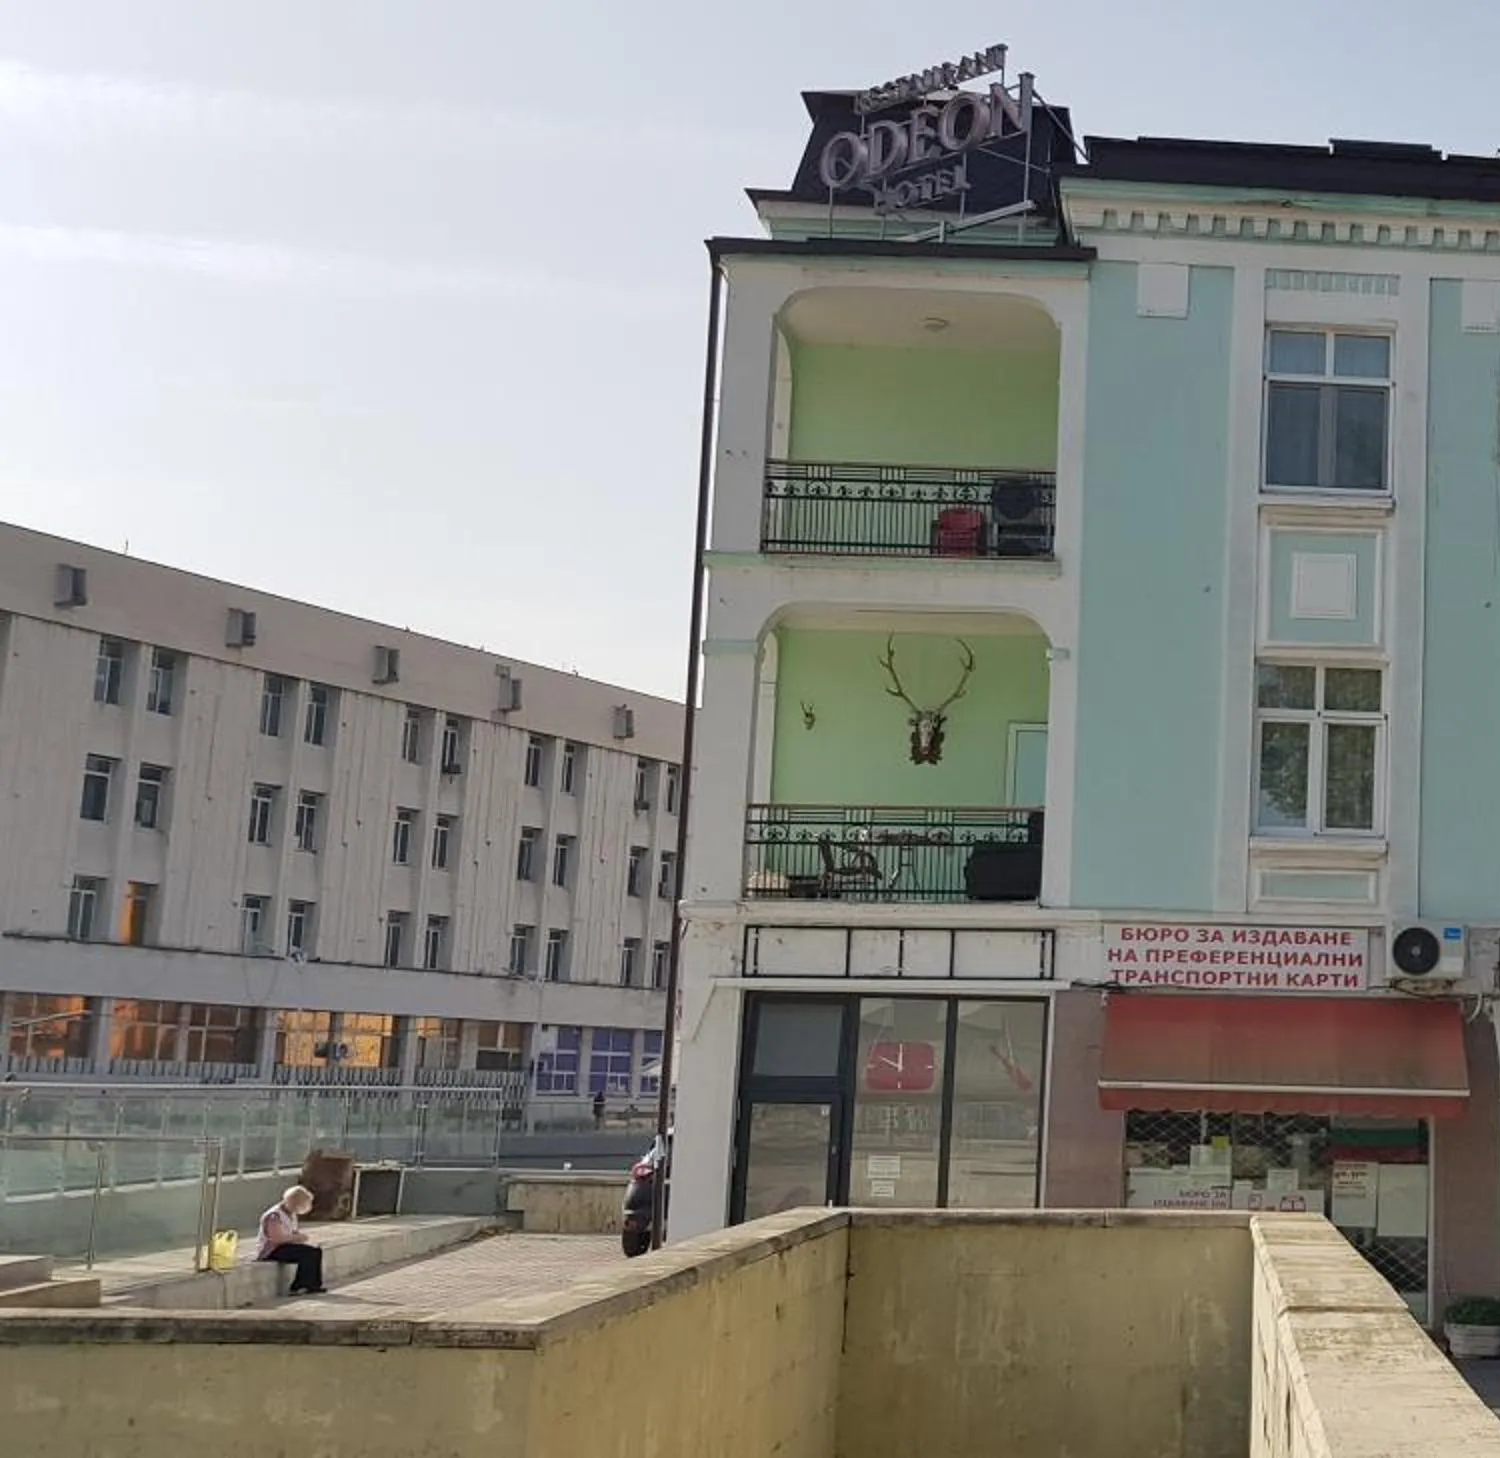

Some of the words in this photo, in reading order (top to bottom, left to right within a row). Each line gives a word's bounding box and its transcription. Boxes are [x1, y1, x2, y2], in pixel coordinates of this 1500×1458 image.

[820, 72, 1035, 188] ODEON
[1120, 927, 1190, 943] БЮРО
[1196, 929, 1225, 943] ЗА
[1232, 929, 1352, 947] ИЗДАВАНЕ
[1107, 948, 1138, 963] НА
[1145, 948, 1363, 968] ПРЕФЕРЕНЦИАЛНИ
[1110, 969, 1278, 987] ТРАНСПОРТНИ
[1286, 972, 1359, 988] КАРТИ
